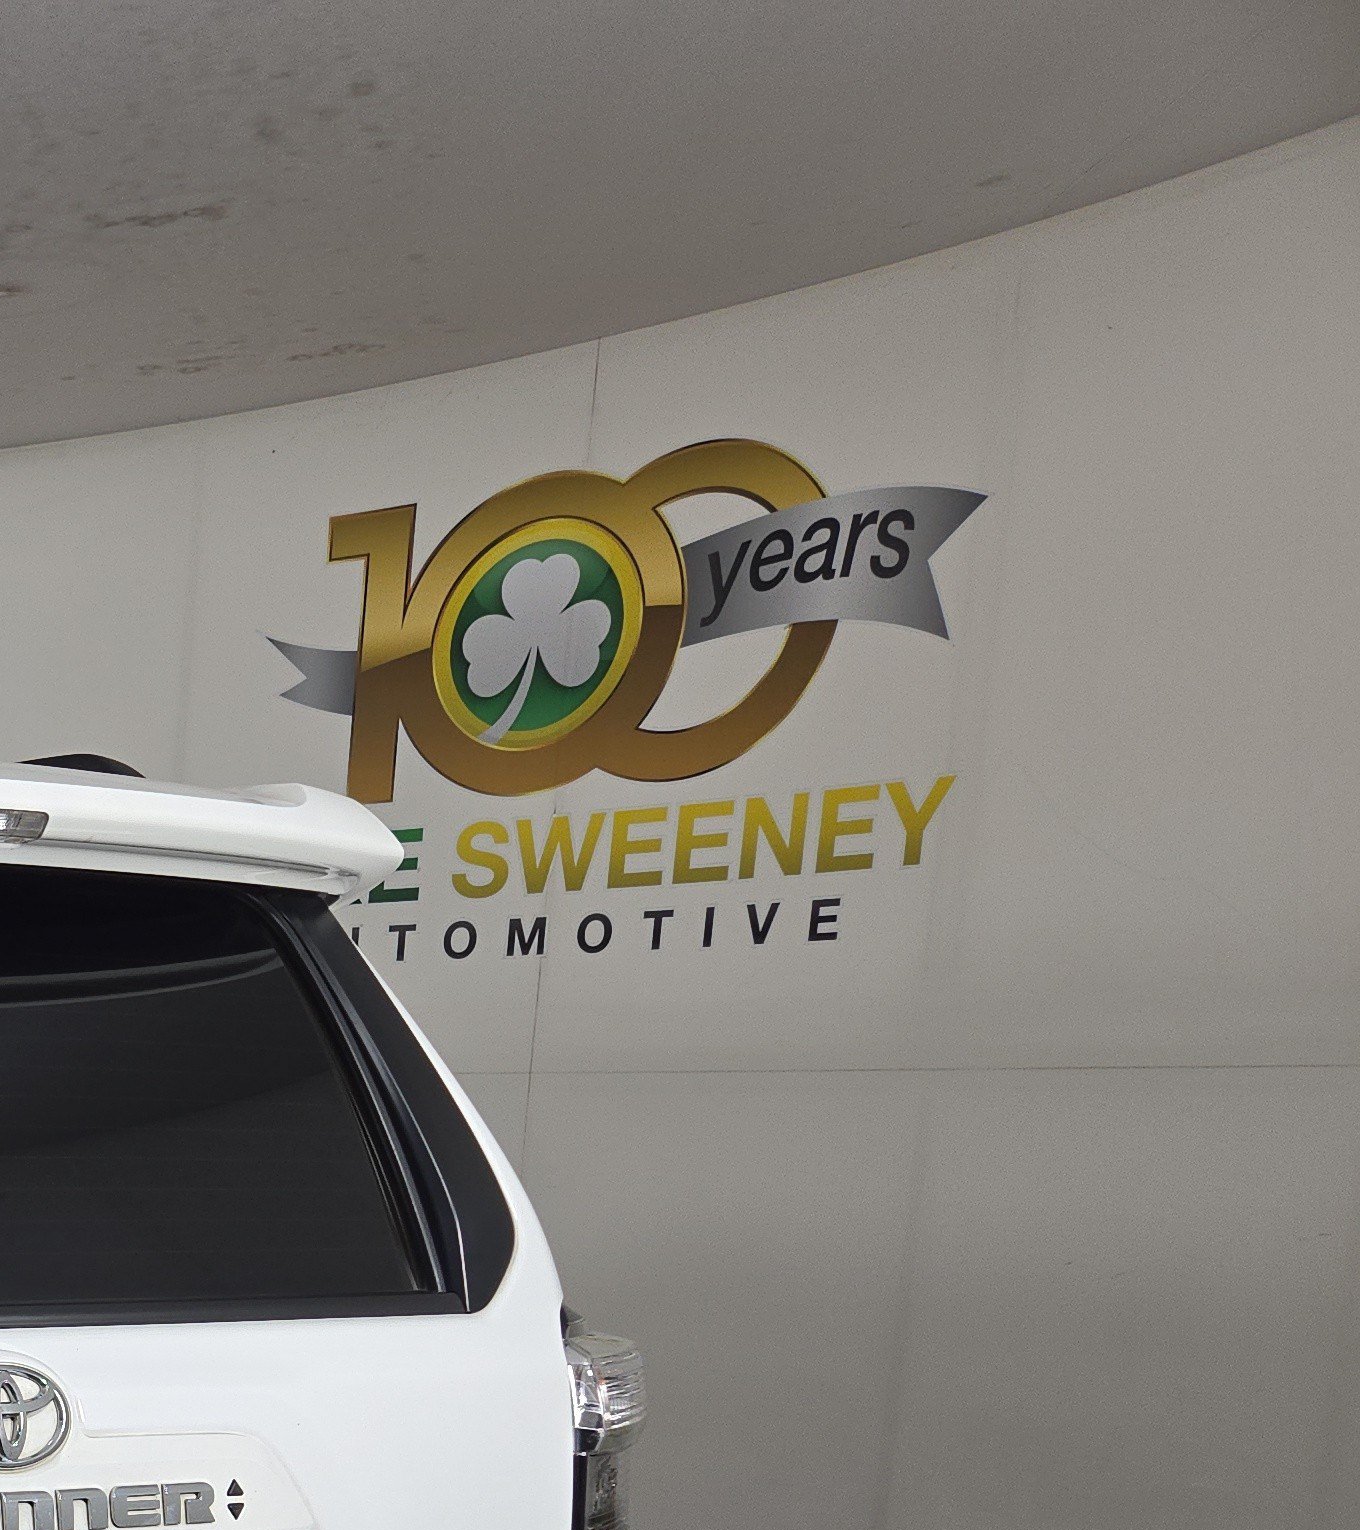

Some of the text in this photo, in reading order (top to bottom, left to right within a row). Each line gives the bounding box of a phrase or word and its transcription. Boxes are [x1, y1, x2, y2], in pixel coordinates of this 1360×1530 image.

[700, 508, 915, 627] years
[451, 775, 957, 899] SWEENEY
[351, 897, 841, 962] TOMOTIVE
